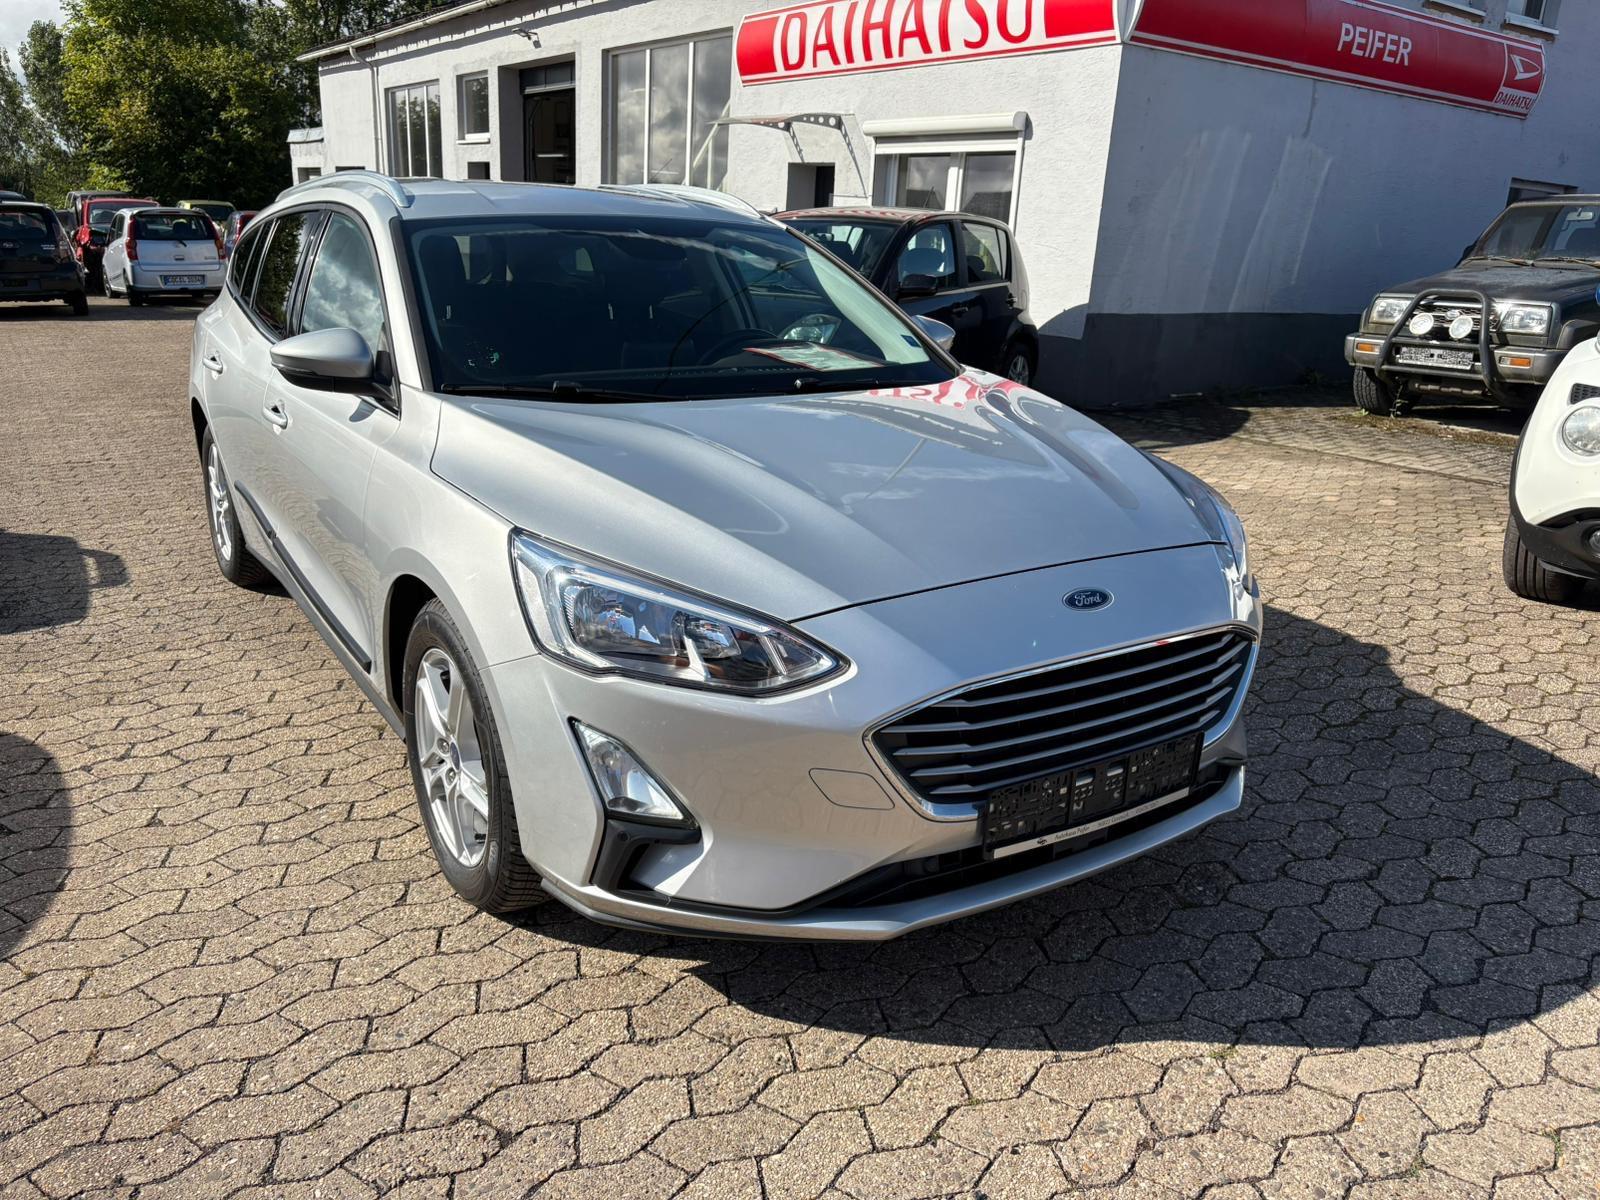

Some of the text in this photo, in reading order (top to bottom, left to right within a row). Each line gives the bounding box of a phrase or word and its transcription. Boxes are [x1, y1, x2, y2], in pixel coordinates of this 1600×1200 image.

[780, 0, 1032, 71] DAIHATSU
[1337, 22, 1412, 66] PEIFER
[1495, 92, 1535, 110] DAIHATSU
[1074, 592, 1102, 606] Ford
